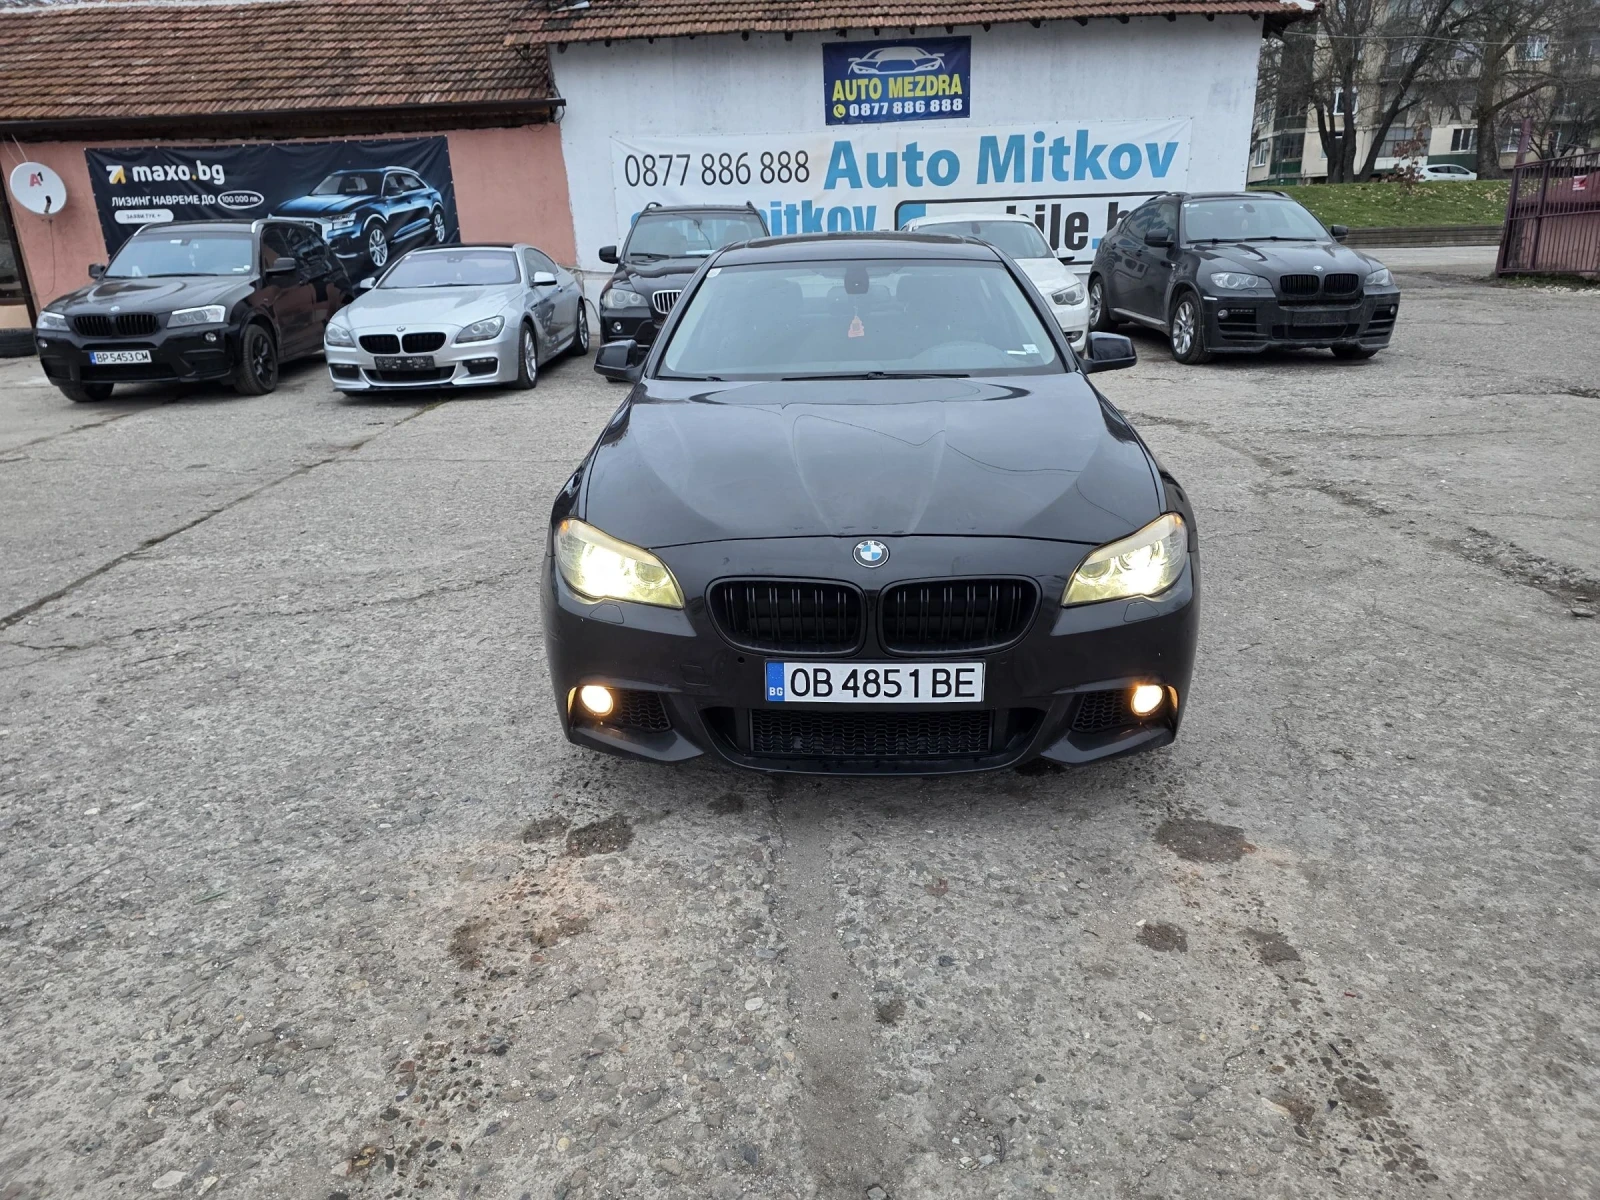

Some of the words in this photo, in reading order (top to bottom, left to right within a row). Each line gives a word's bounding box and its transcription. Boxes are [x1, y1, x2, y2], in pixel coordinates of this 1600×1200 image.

[832, 77, 882, 101] AUTO
[889, 74, 962, 98] MEZDRA
[849, 102, 889, 117] 0877
[893, 101, 925, 115] 886
[930, 98, 963, 113] 888
[624, 153, 691, 187] 0877
[701, 152, 751, 186] 886
[760, 150, 810, 184] 888
[823, 140, 961, 190] Auto
[976, 129, 1179, 185] Mitkov
[30, 171, 44, 187] A1
[131, 160, 225, 185] maxo.bg
[111, 196, 151, 207] ЛИЗИНГ
[152, 194, 200, 206] НАВРЕМЕ
[201, 194, 216, 206] ДО
[222, 195, 234, 203] 100
[234, 195, 249, 203] 000
[109, 352, 134, 362] 5453
[135, 351, 149, 361] CM
[769, 687, 784, 697] BG
[790, 668, 833, 698] OB
[841, 668, 920, 698] 4851
[931, 668, 975, 698] BE
